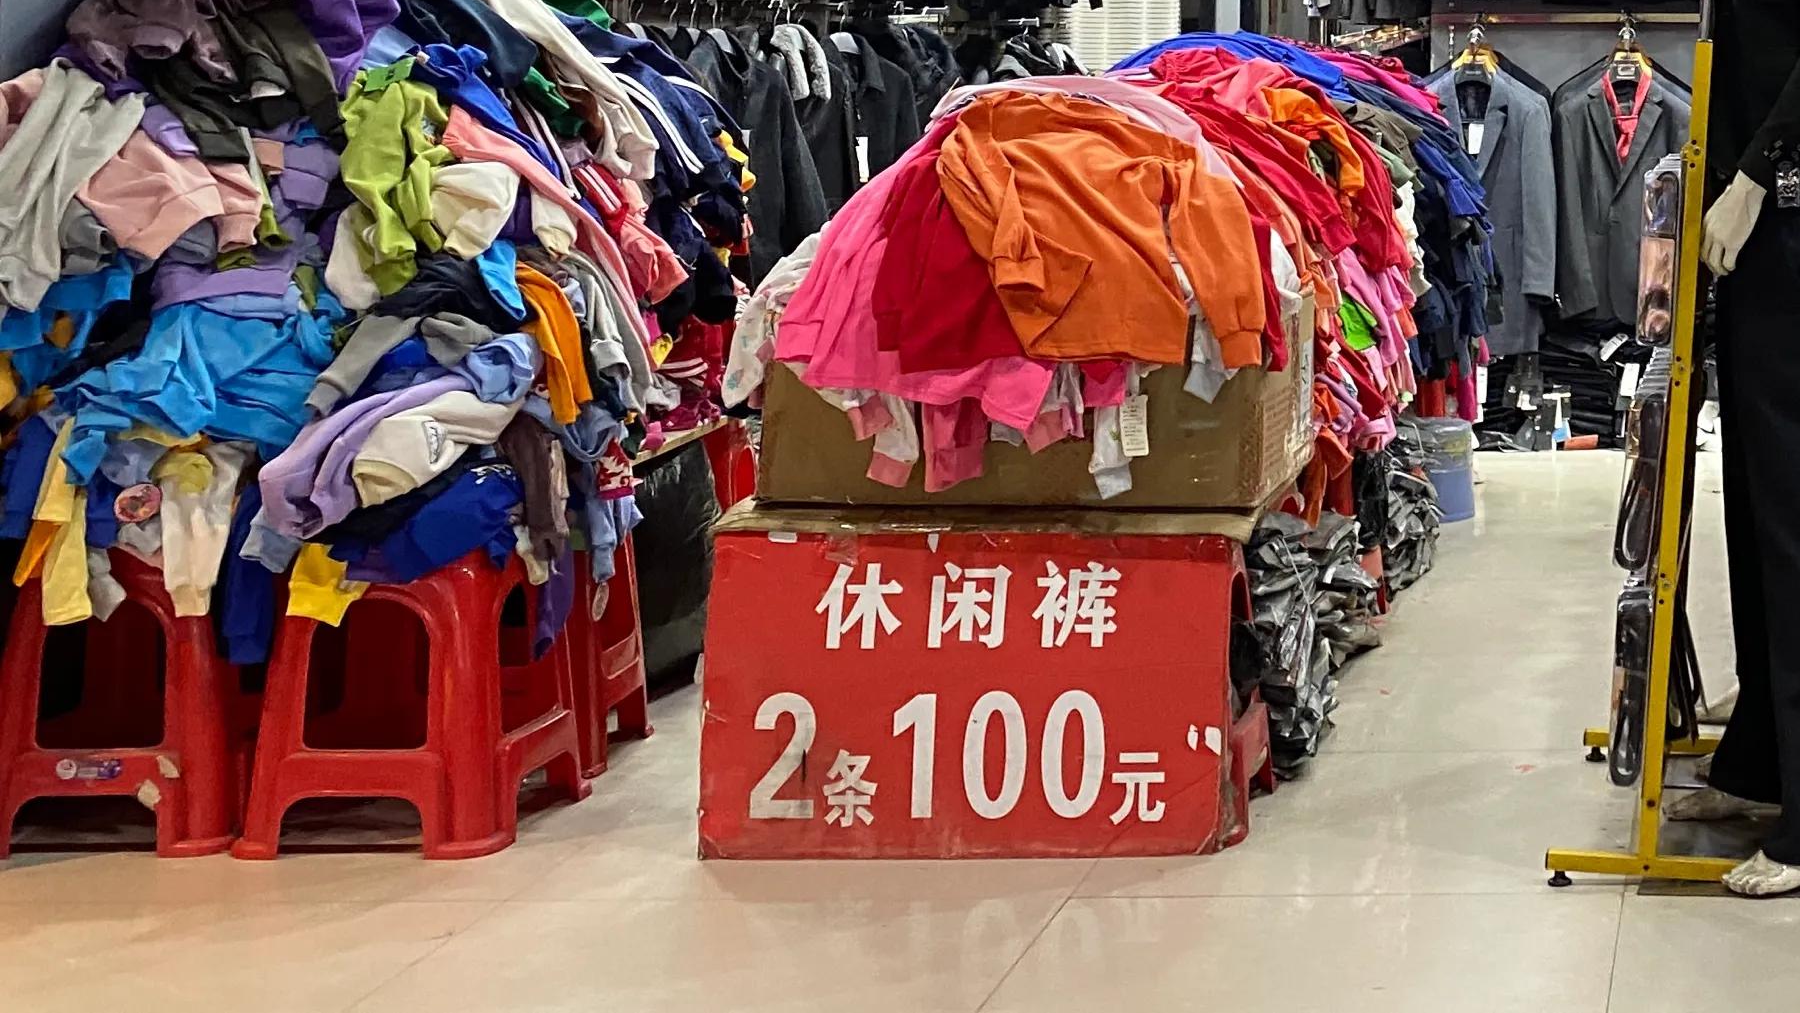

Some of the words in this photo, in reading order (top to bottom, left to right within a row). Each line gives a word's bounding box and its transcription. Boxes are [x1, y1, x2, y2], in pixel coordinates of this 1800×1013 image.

[815, 560, 1122, 649] 休闲裤
[749, 689, 1166, 827] 2条100元
